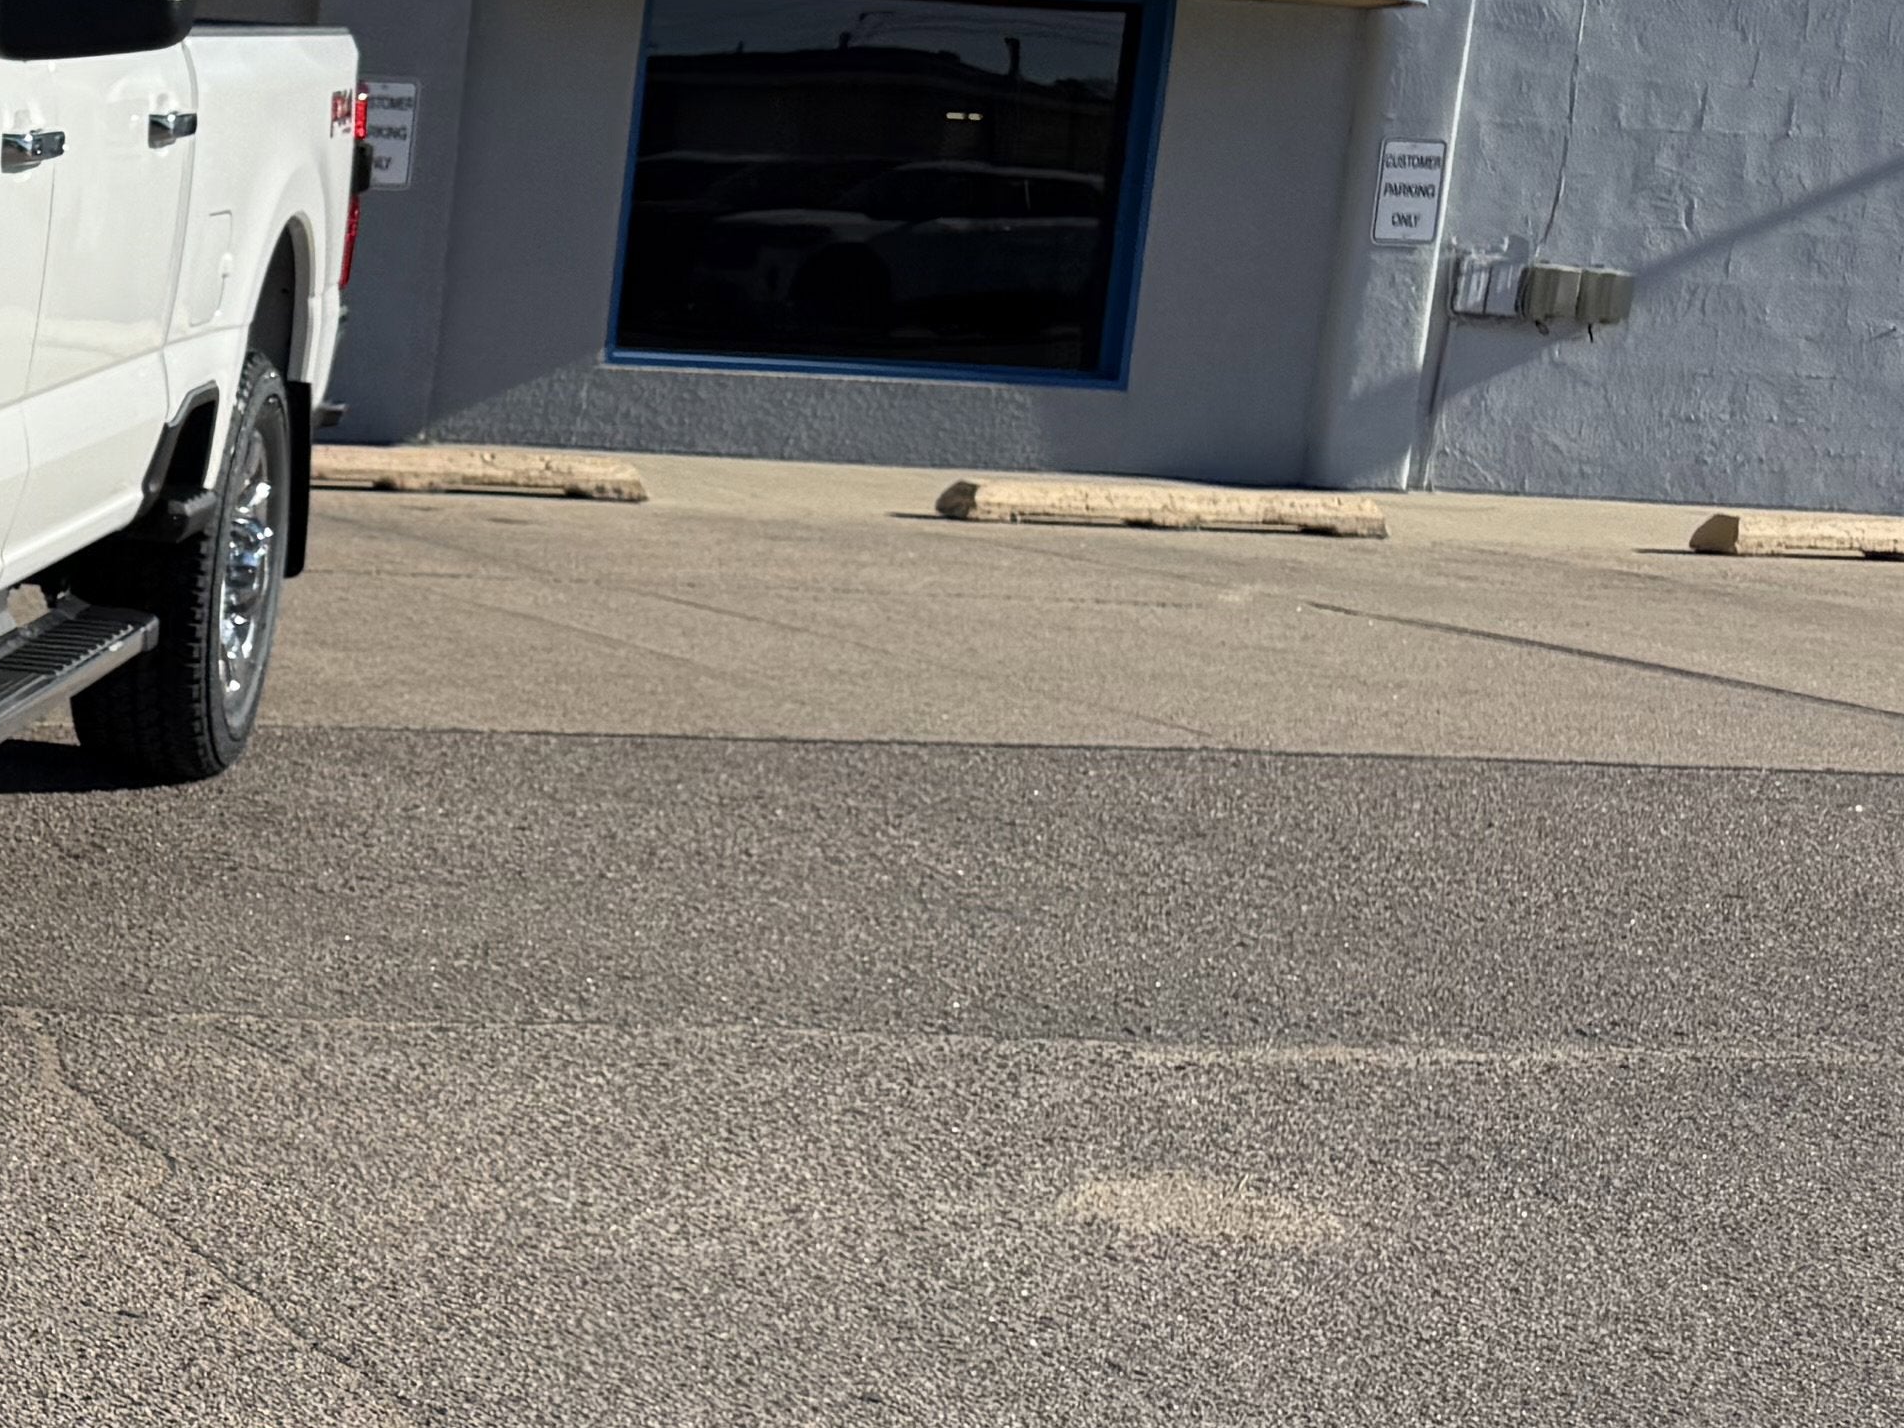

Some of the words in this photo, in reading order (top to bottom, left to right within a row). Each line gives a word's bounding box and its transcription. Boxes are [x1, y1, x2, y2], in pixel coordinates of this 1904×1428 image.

[1384, 153, 1441, 170] CUSTOMER
[1383, 181, 1436, 199] PARKING
[1391, 212, 1420, 228] ONLY
